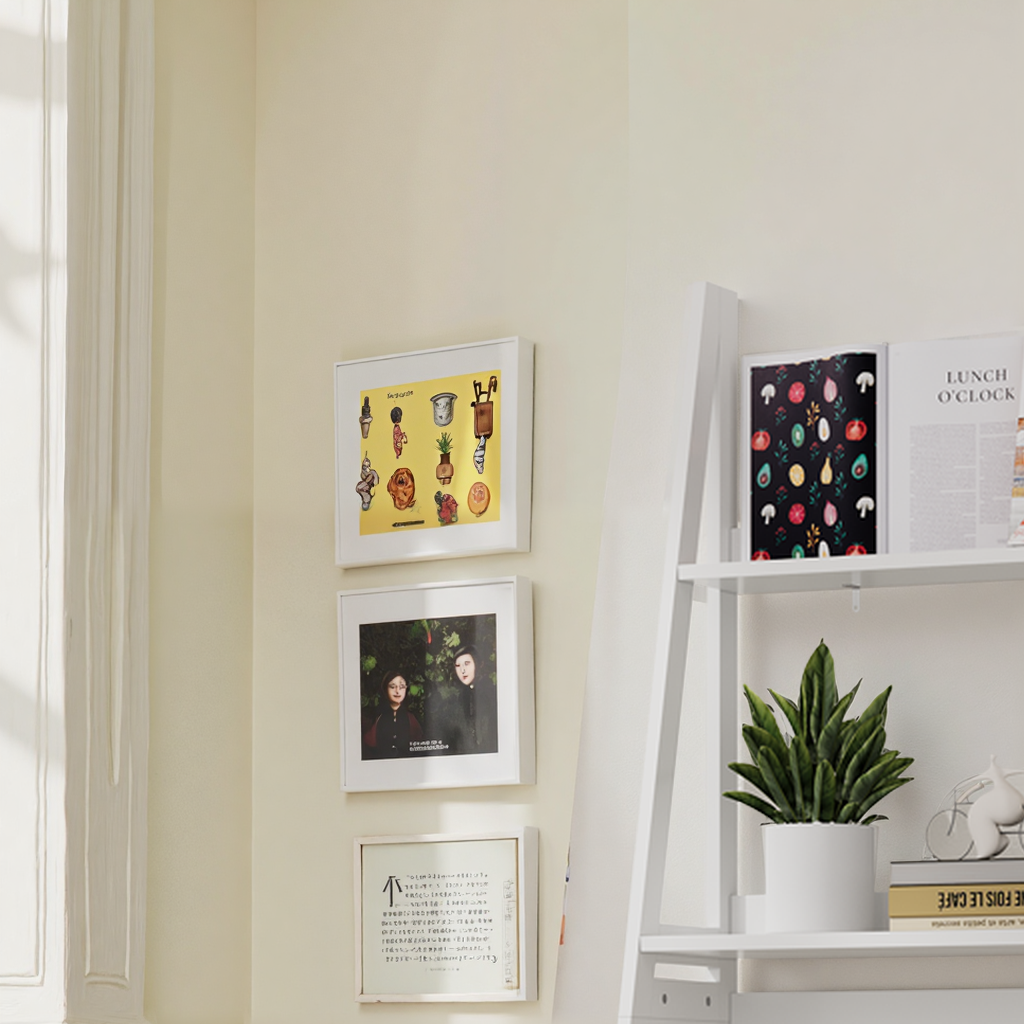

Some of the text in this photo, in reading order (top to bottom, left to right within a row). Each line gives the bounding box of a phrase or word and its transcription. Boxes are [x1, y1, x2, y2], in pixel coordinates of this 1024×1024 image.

[947, 368, 1007, 384] LUNCH
[937, 387, 1015, 404] O'CLOCK
[938, 891, 967, 912] CAFÉ
[969, 890, 984, 908] LE
[985, 890, 1011, 907] FOIS
